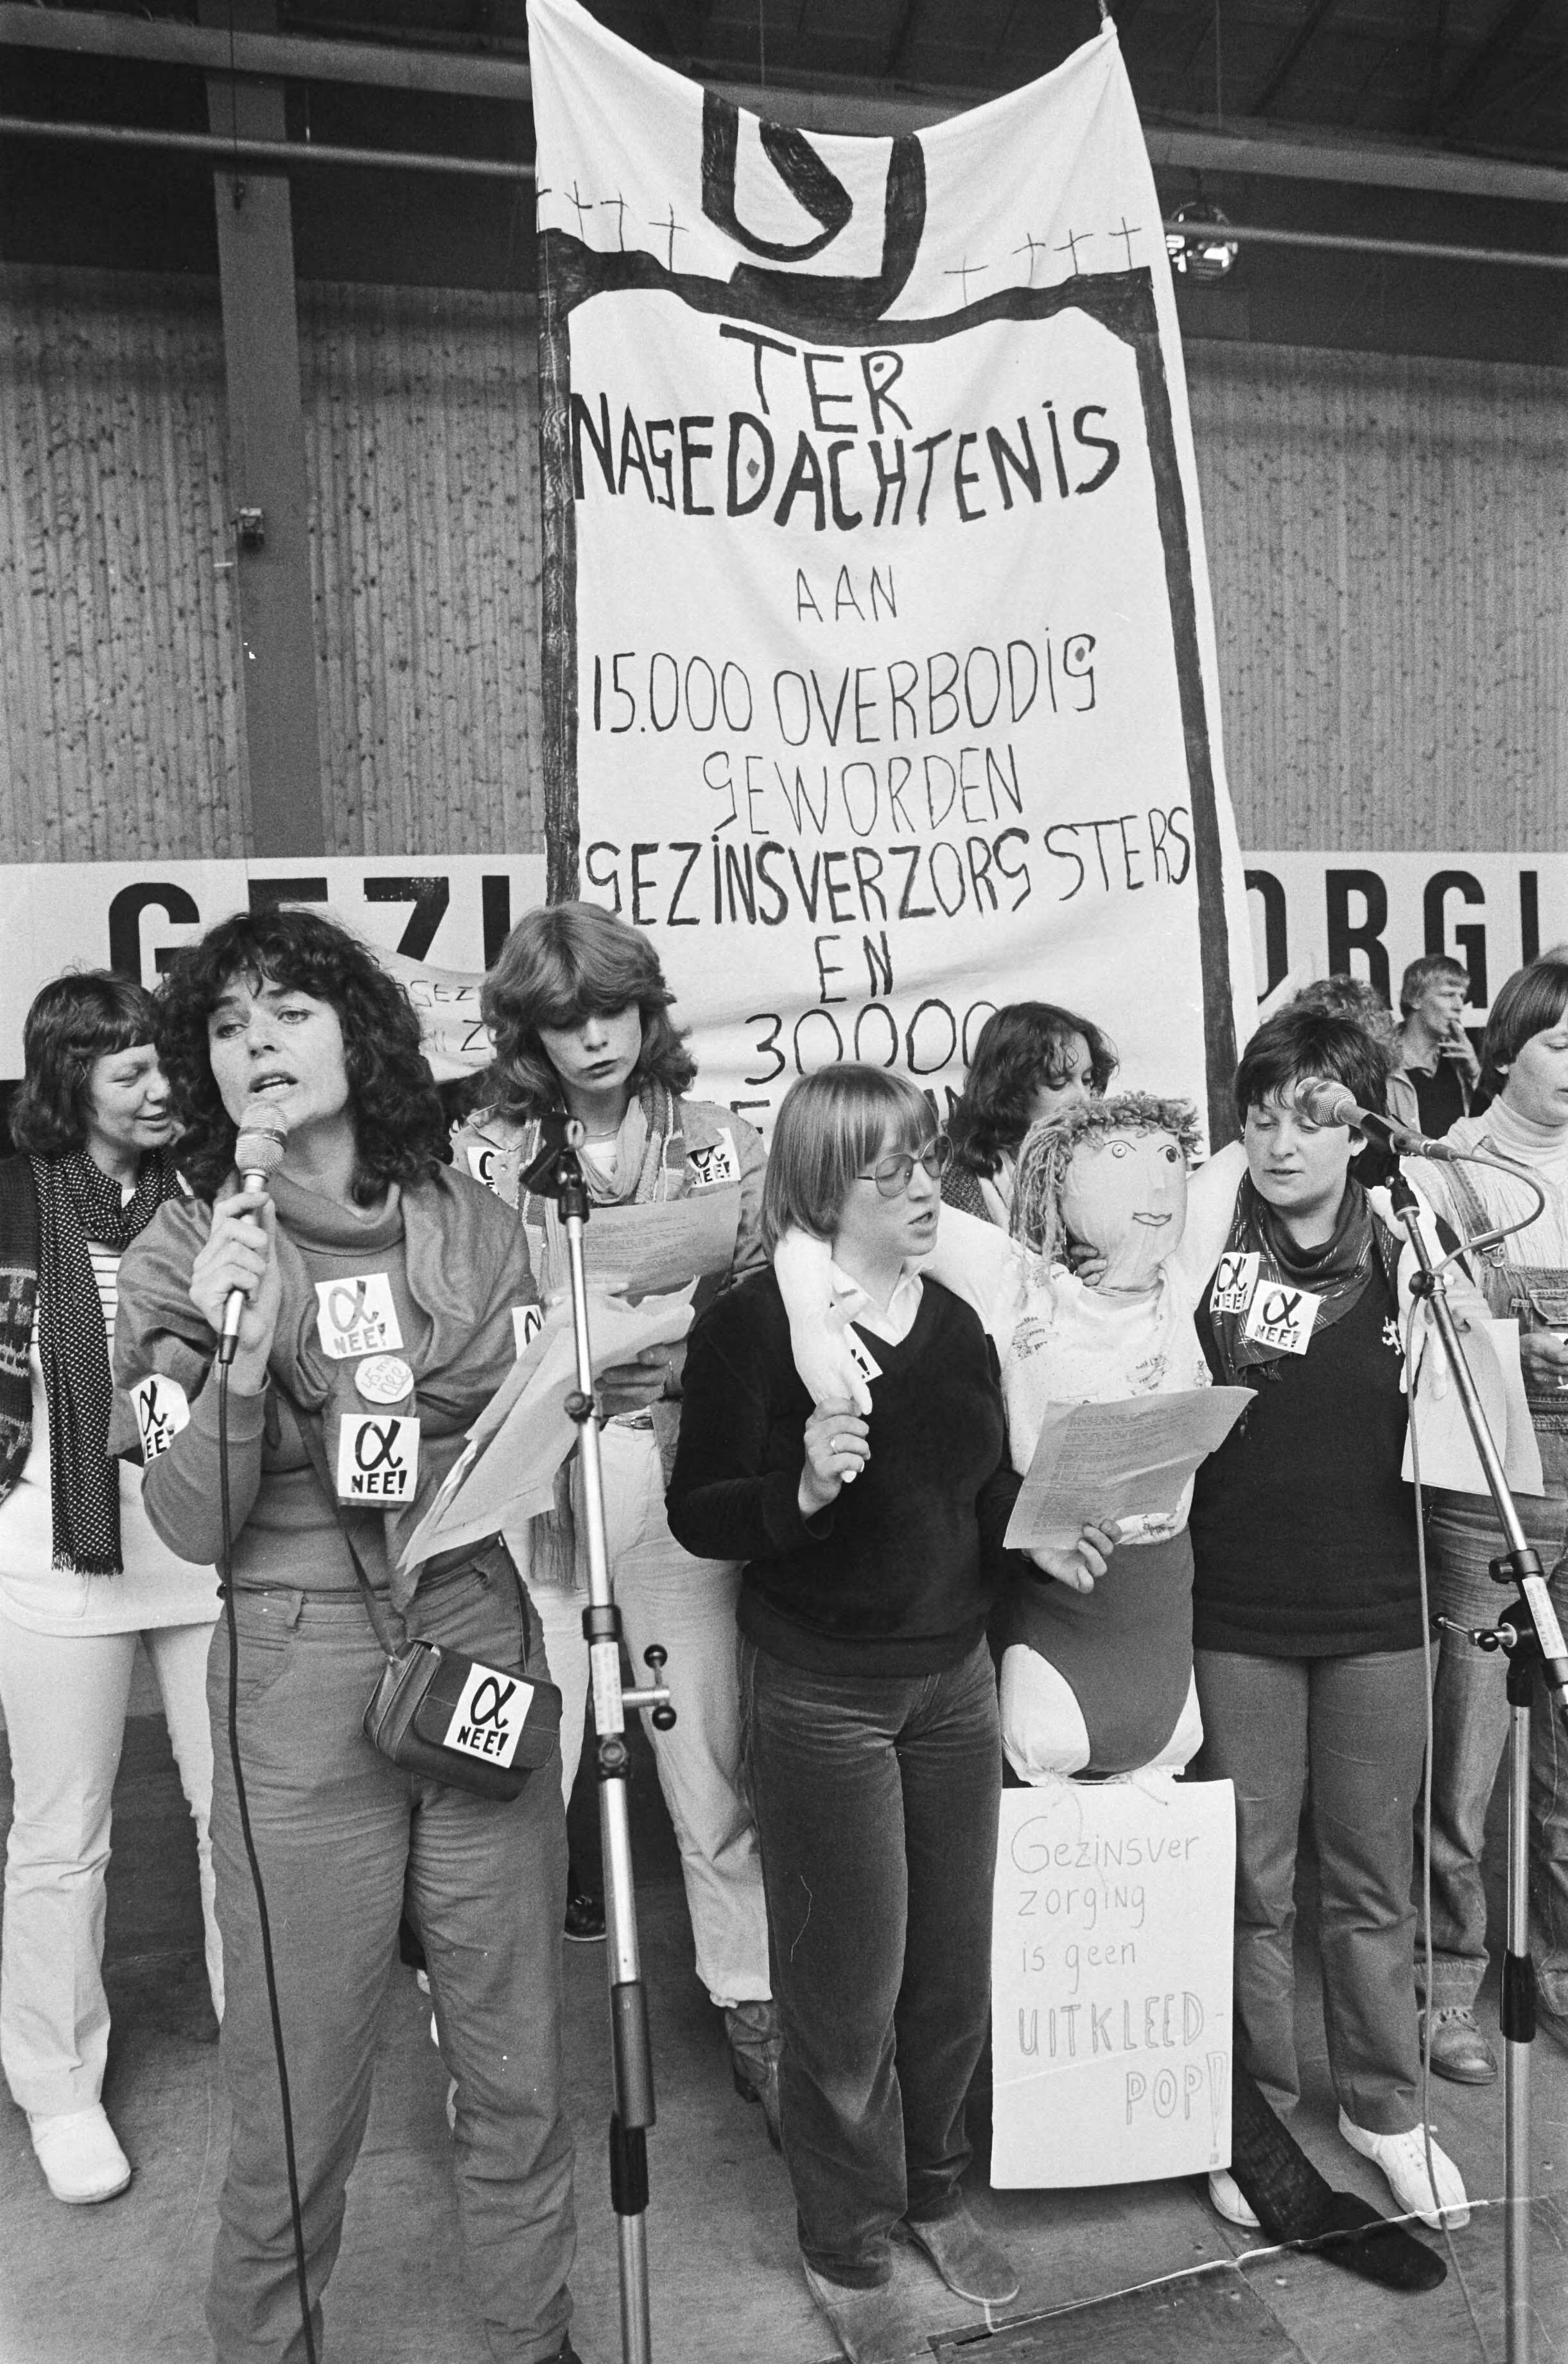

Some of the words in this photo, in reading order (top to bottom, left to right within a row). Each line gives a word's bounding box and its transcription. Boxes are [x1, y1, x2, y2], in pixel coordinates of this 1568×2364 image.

[719, 324, 912, 435] TER
[796, 565, 897, 623] AAN
[593, 651, 753, 733] 15.000
[815, 931, 894, 1003] EN
[333, 1321, 387, 1355] NEE!
[1255, 1324, 1302, 1348] NEE!
[351, 1469, 408, 1495] NEE!
[457, 1725, 510, 1757] NEE!
[1022, 1942, 1045, 1972] is
[1065, 1942, 1136, 1994] geen
[1126, 2052, 1228, 2166] POP!
